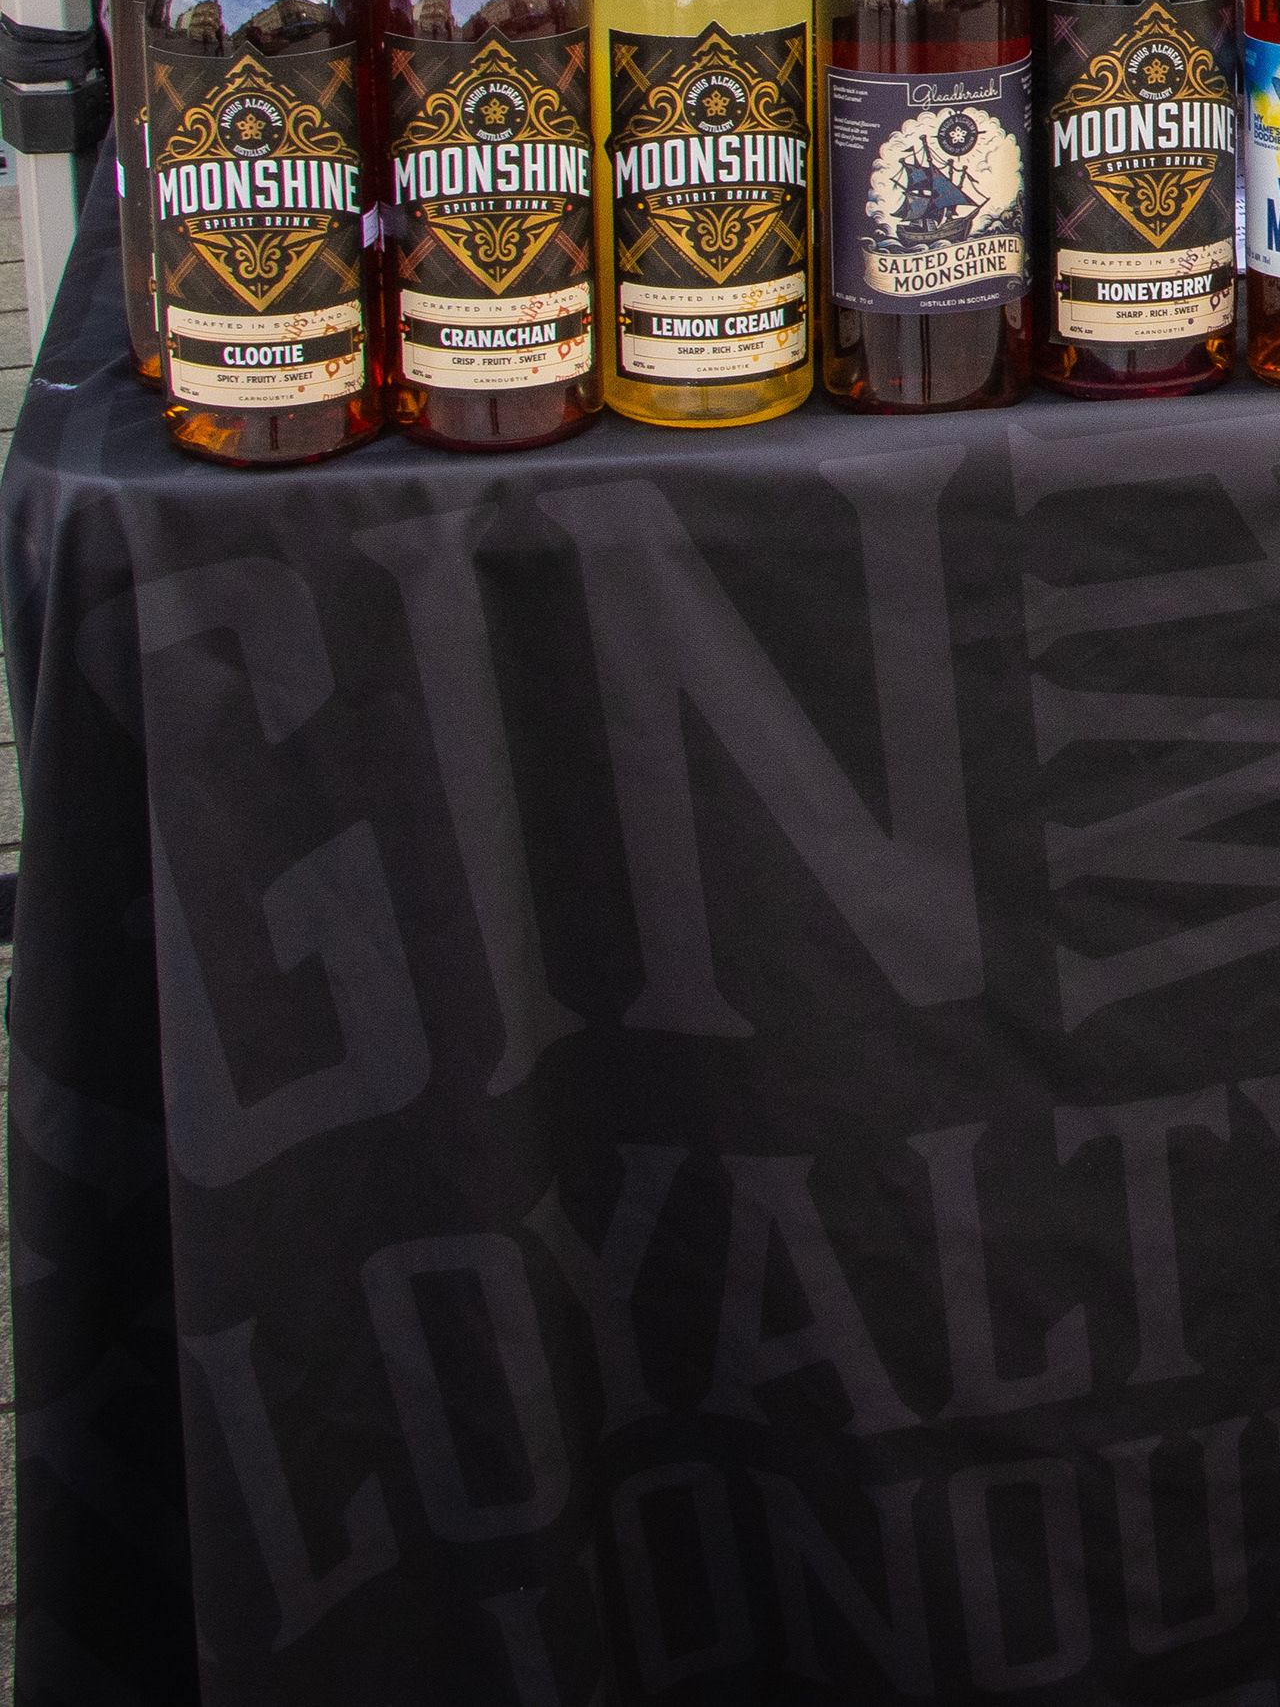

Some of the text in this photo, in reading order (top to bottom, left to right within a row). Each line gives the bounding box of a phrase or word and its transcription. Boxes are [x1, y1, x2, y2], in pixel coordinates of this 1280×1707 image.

[220, 98, 283, 129] ANGUS ALCHEMY
[1052, 101, 1235, 167] MOONSHINE
[233, 144, 272, 157] DISTILLERY
[394, 143, 590, 205] MOONSHINE
[615, 134, 807, 199] MOONSHINE
[1107, 156, 1204, 172] SPIRIT DRINK
[158, 159, 361, 220] MOONSHINE
[667, 190, 768, 206] SPIRIT DRINK
[444, 200, 549, 214] SPIRIT DRINK
[204, 217, 311, 230] SPIRIT DRINK
[878, 239, 1020, 275] SALTED CARAMEL
[894, 255, 1007, 292] MOONSHINE
[1097, 275, 1213, 302] HONEYBERRY
[652, 308, 785, 337] LEMON CREAM
[1116, 305, 1199, 319] SHARP RICH SWEET
[440, 323, 557, 348] CRANACHAN
[222, 344, 305, 366] CLOOTIE
[452, 353, 547, 366] CRISP FRUITY SWEET
[677, 342, 764, 355] SHARP RICH SWEET
[217, 371, 313, 384] SPICY FRUITY SWEET
